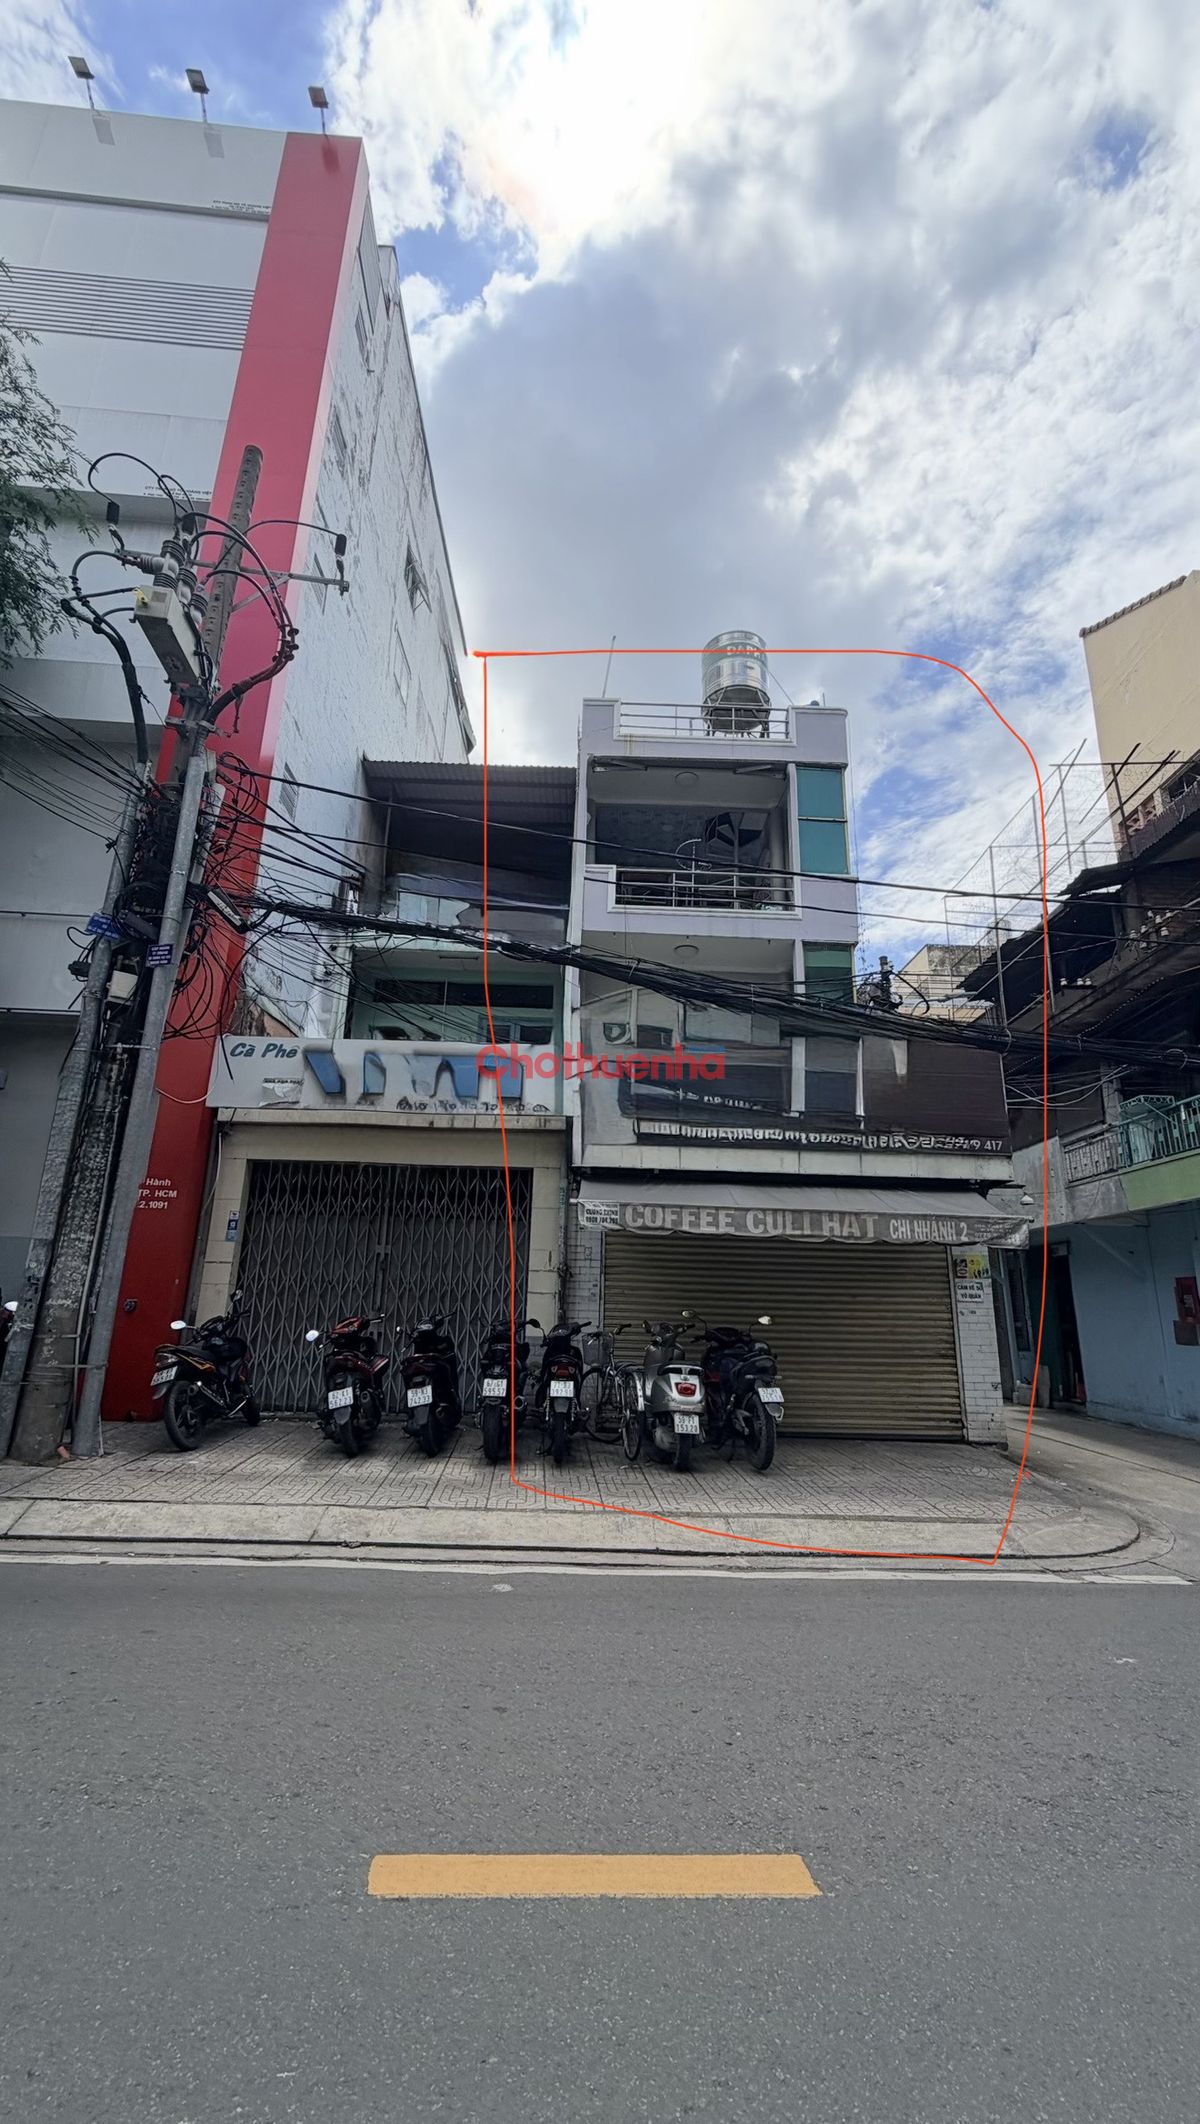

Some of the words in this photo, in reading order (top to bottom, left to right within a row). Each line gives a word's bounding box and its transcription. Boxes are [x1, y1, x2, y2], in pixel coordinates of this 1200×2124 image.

[229, 1042, 256, 1057] Cà
[145, 1178, 171, 1187] Hành
[154, 1190, 177, 1198] HCM
[137, 1201, 168, 1209] 2.1091
[624, 1204, 736, 1232] COFFEE
[745, 1209, 812, 1235] CULI
[889, 1218, 911, 1239] CHI
[913, 1216, 957, 1241] NHÁNH
[959, 1222, 969, 1241] 2
